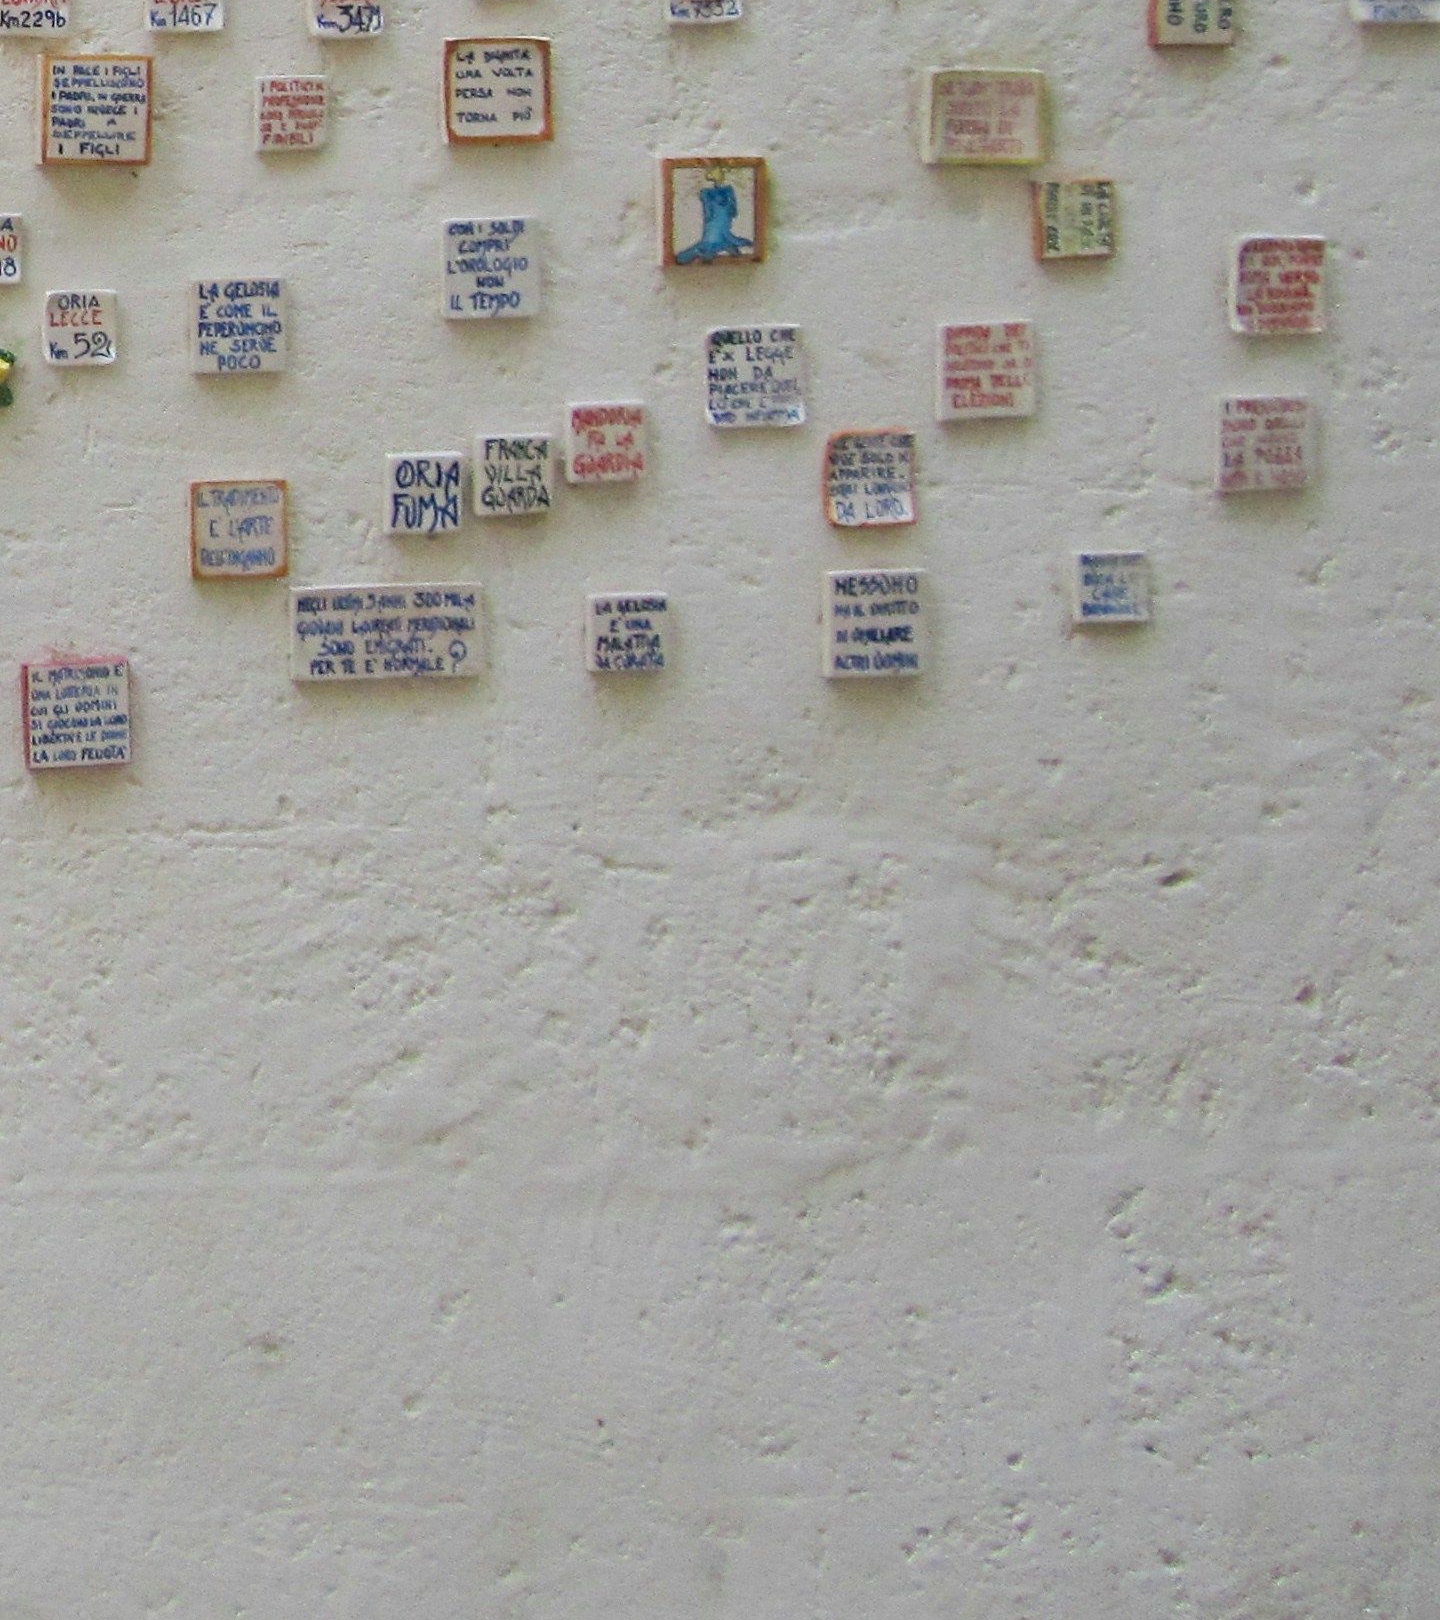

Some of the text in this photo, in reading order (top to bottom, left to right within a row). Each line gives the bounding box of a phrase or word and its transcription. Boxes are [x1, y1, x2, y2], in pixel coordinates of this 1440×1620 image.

[58, 295, 100, 310] ORIA
[469, 291, 520, 315] TEMPO
[50, 310, 103, 327] LECCE
[396, 460, 459, 496] ORIA
[392, 492, 458, 532] FUMA
